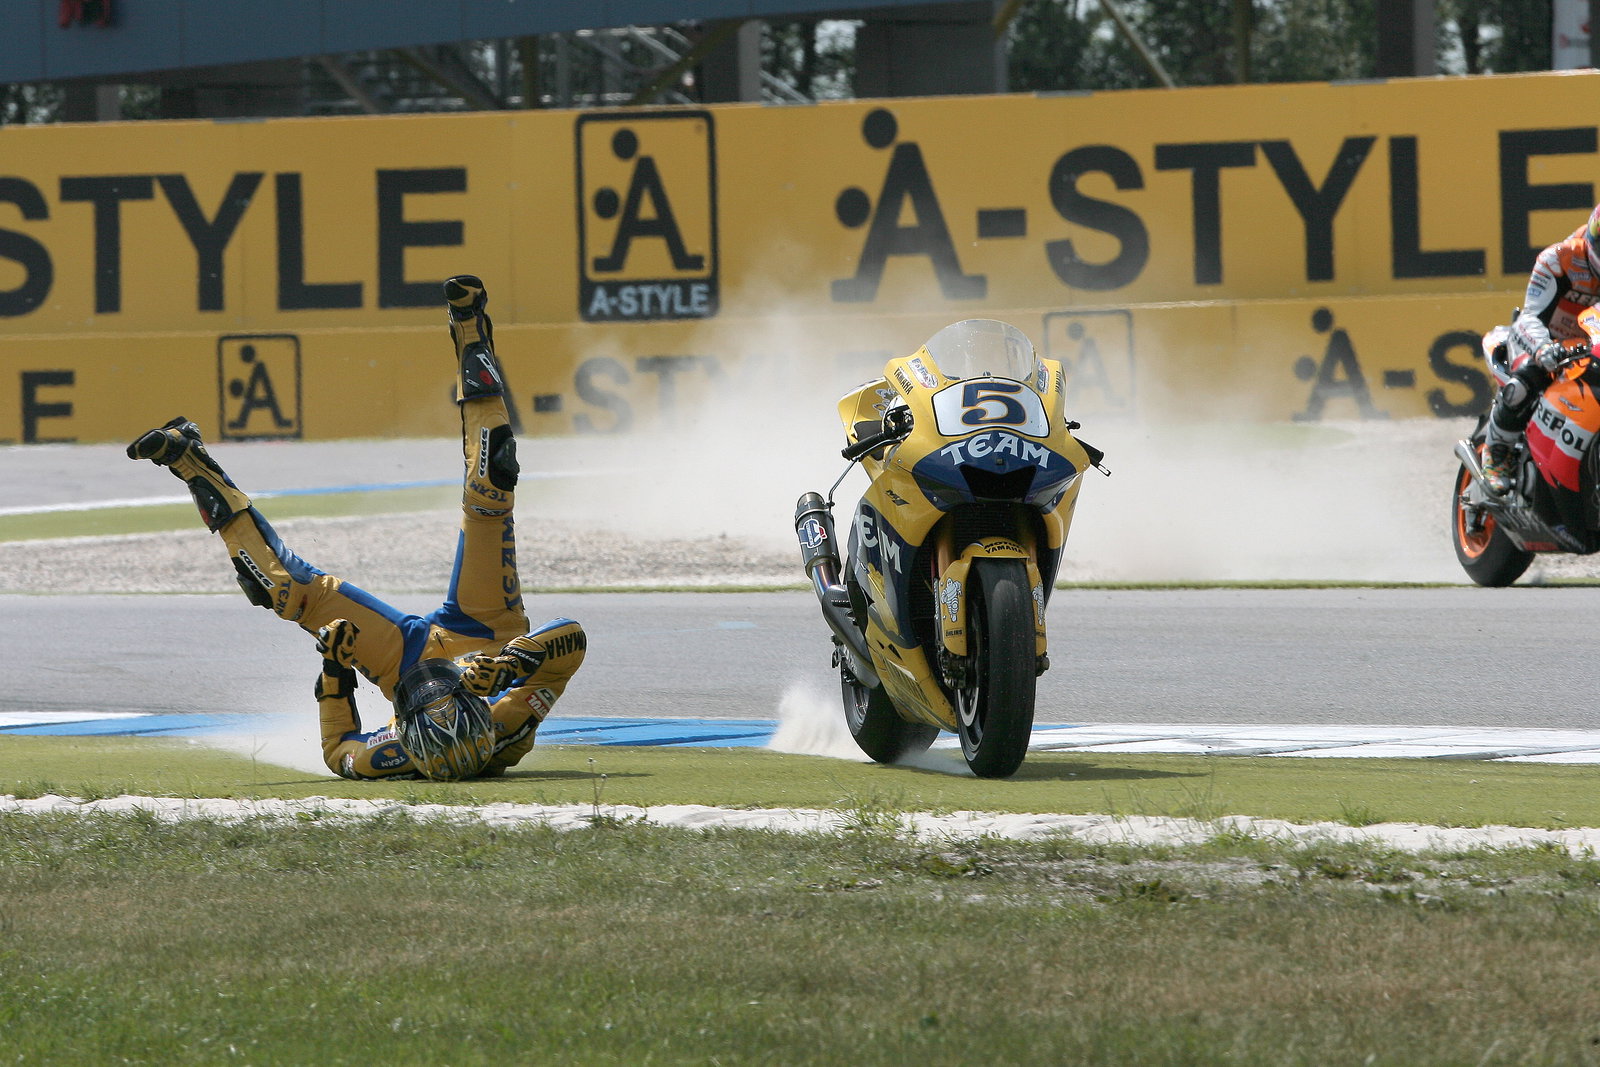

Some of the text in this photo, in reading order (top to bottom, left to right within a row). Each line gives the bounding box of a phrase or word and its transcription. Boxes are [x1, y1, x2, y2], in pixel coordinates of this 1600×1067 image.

[831, 127, 1599, 303] A-STYLE
[589, 284, 710, 317] A-STYLE
[961, 381, 1027, 427] 5
[940, 432, 1051, 468] TEAM
[985, 545, 1024, 555] YAMAHA
[381, 755, 406, 768] TEAM
